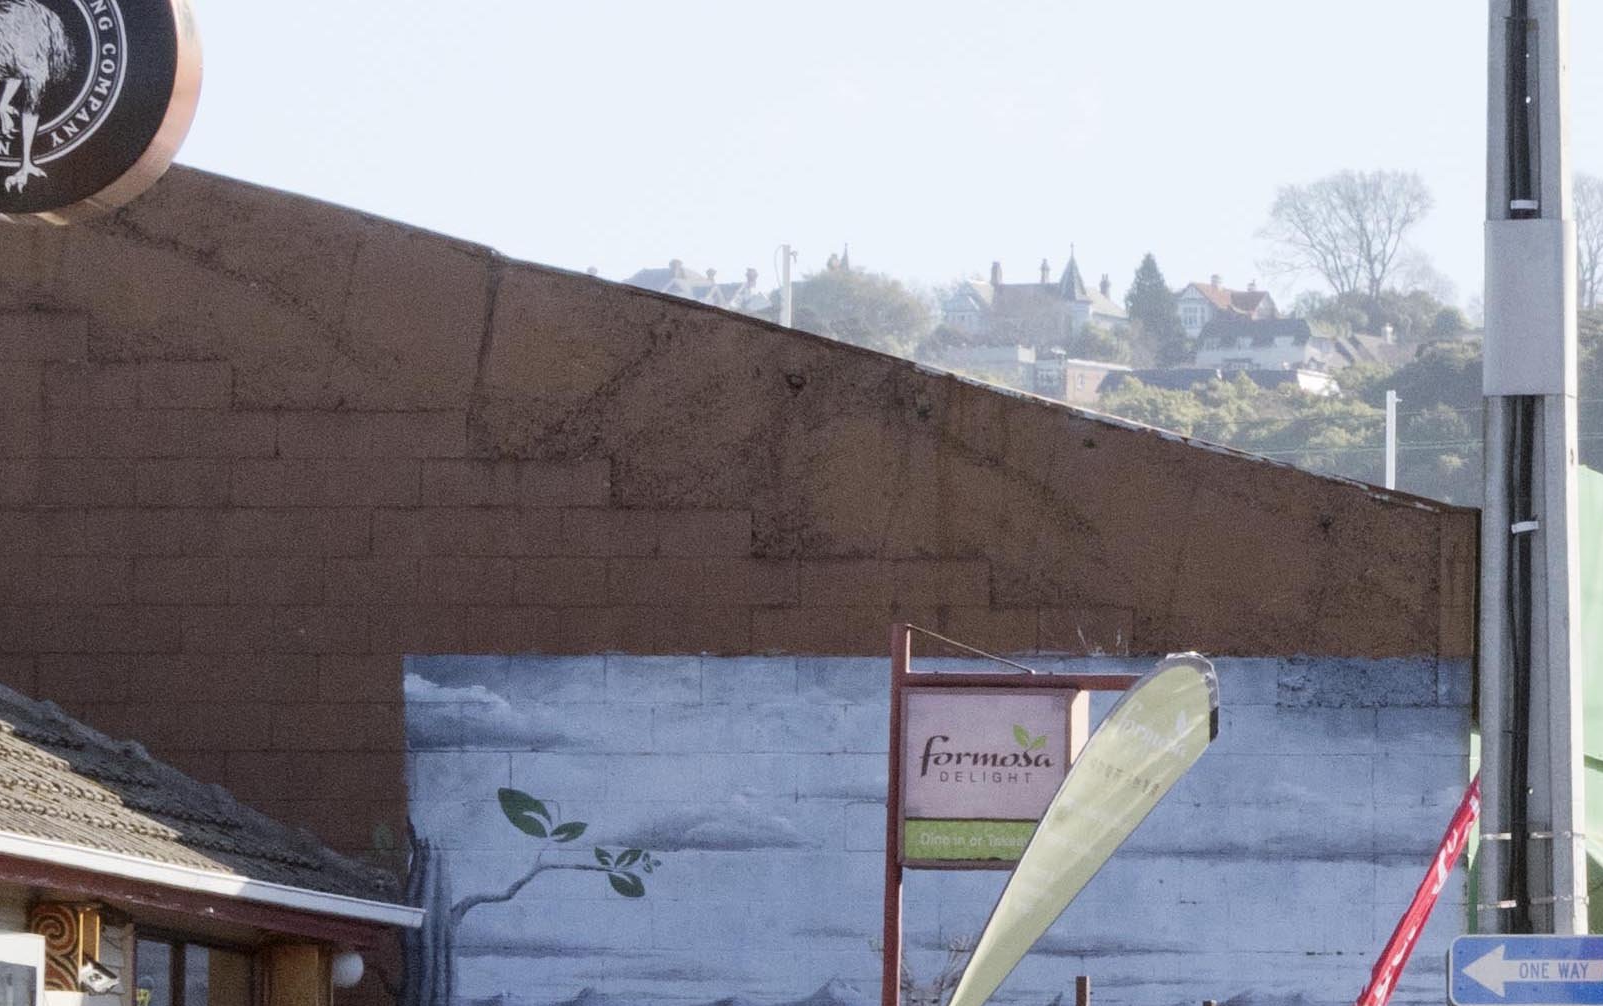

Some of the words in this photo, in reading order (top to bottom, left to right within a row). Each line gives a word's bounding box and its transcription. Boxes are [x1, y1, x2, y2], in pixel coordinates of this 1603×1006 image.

[51, 42, 117, 148] COMPANY
[939, 771, 1033, 784] DELIGHT
[969, 834, 983, 846] or
[1518, 962, 1549, 979] ONE
[1558, 962, 1590, 979] WAY
